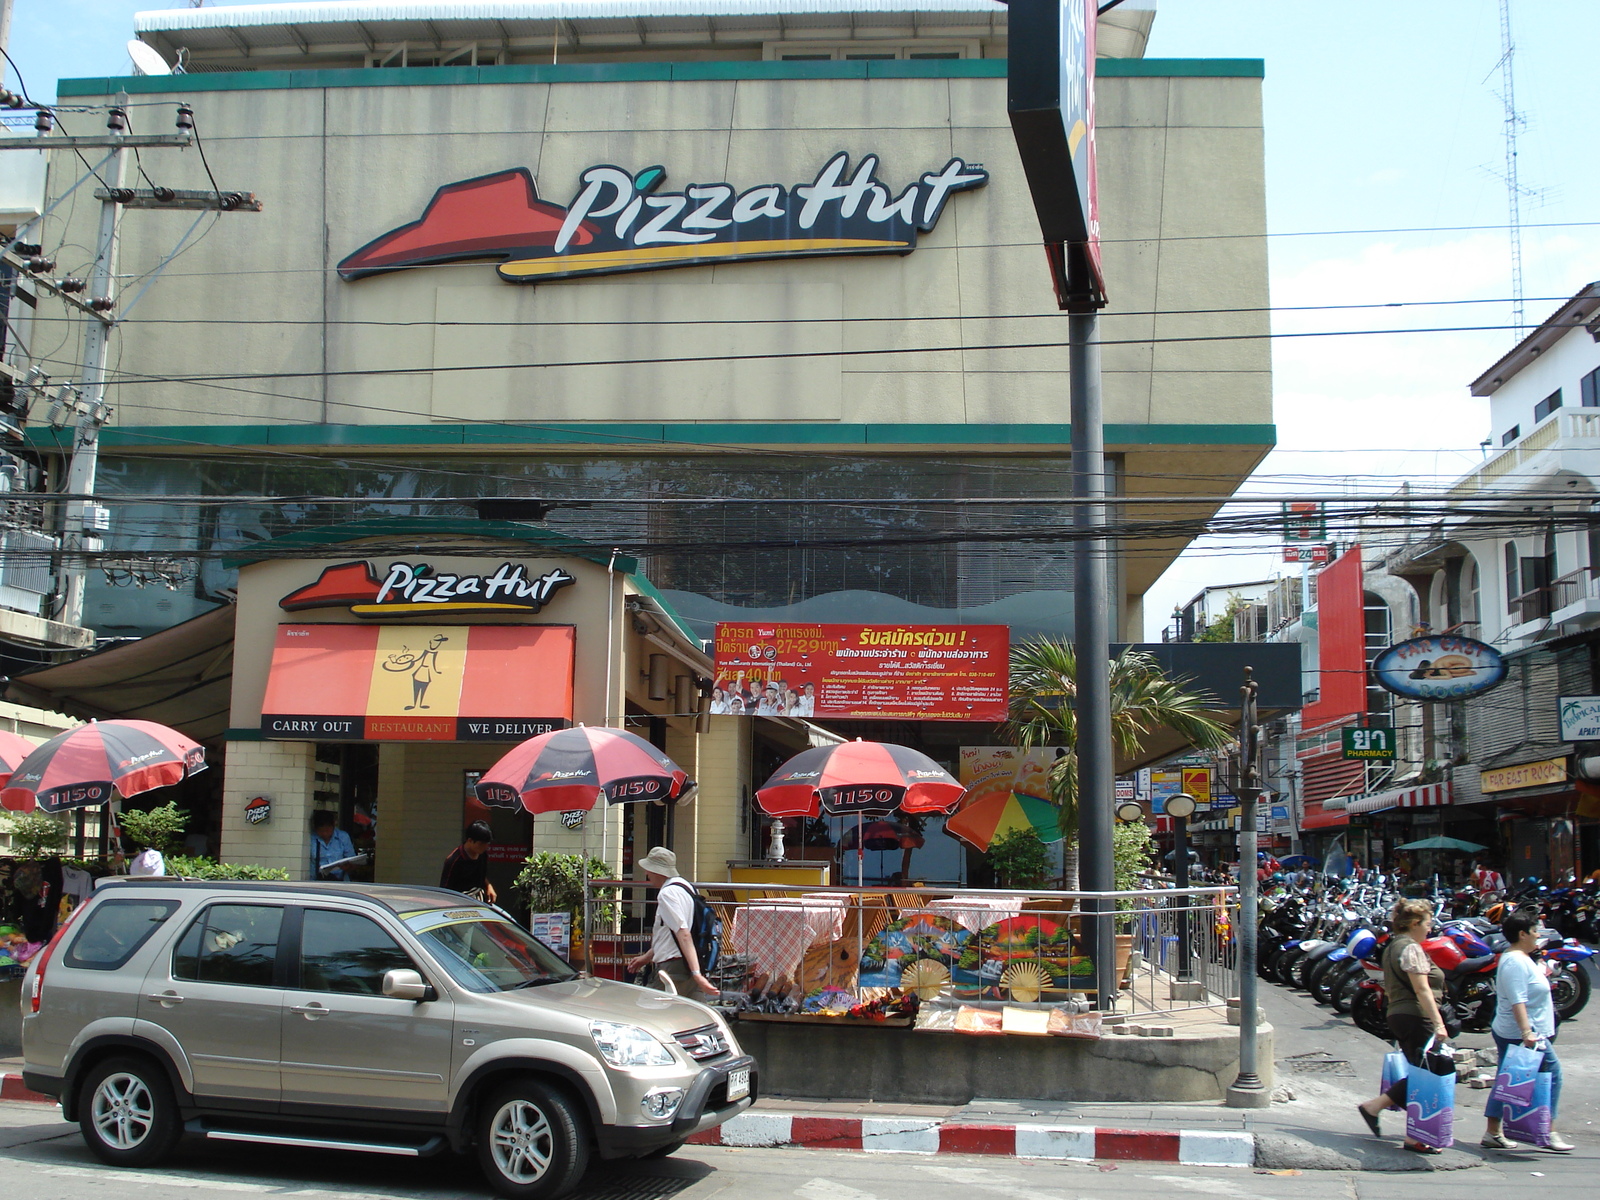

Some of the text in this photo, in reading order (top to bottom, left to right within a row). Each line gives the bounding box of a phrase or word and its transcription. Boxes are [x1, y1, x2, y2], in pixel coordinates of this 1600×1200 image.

[554, 155, 986, 254] Pizza Hut
[1299, 549, 1312, 559] 24
[376, 562, 571, 604] Pizza Hut
[720, 623, 754, 639] ค่ารถ
[757, 628, 775, 636] Yum!
[776, 624, 825, 639] ค่าแรงชม.
[859, 628, 956, 646] รับสมัครด่วน
[716, 638, 749, 654] ปิดร้าน
[777, 639, 819, 654] 27-29
[836, 648, 989, 659] พนักงานประจำร้าน พนักงานส่งอาหาร
[1397, 637, 1487, 659] FAR EAST
[745, 668, 762, 682] 40
[1420, 682, 1475, 699] ROCK
[272, 720, 352, 732] CARRY OUT
[371, 722, 451, 733] RESTAURANT
[468, 722, 552, 734] WE DELIVER
[1353, 730, 1386, 750] ยา
[1489, 764, 1555, 786] FAR EAST ROCK
[50, 786, 102, 805] 1150
[612, 780, 660, 799] 1150
[834, 788, 893, 805] 1150
[1116, 789, 1133, 798] OOMS
[247, 805, 270, 820] Pizza
[251, 811, 268, 822] Hut
[567, 816, 583, 827] Hut
